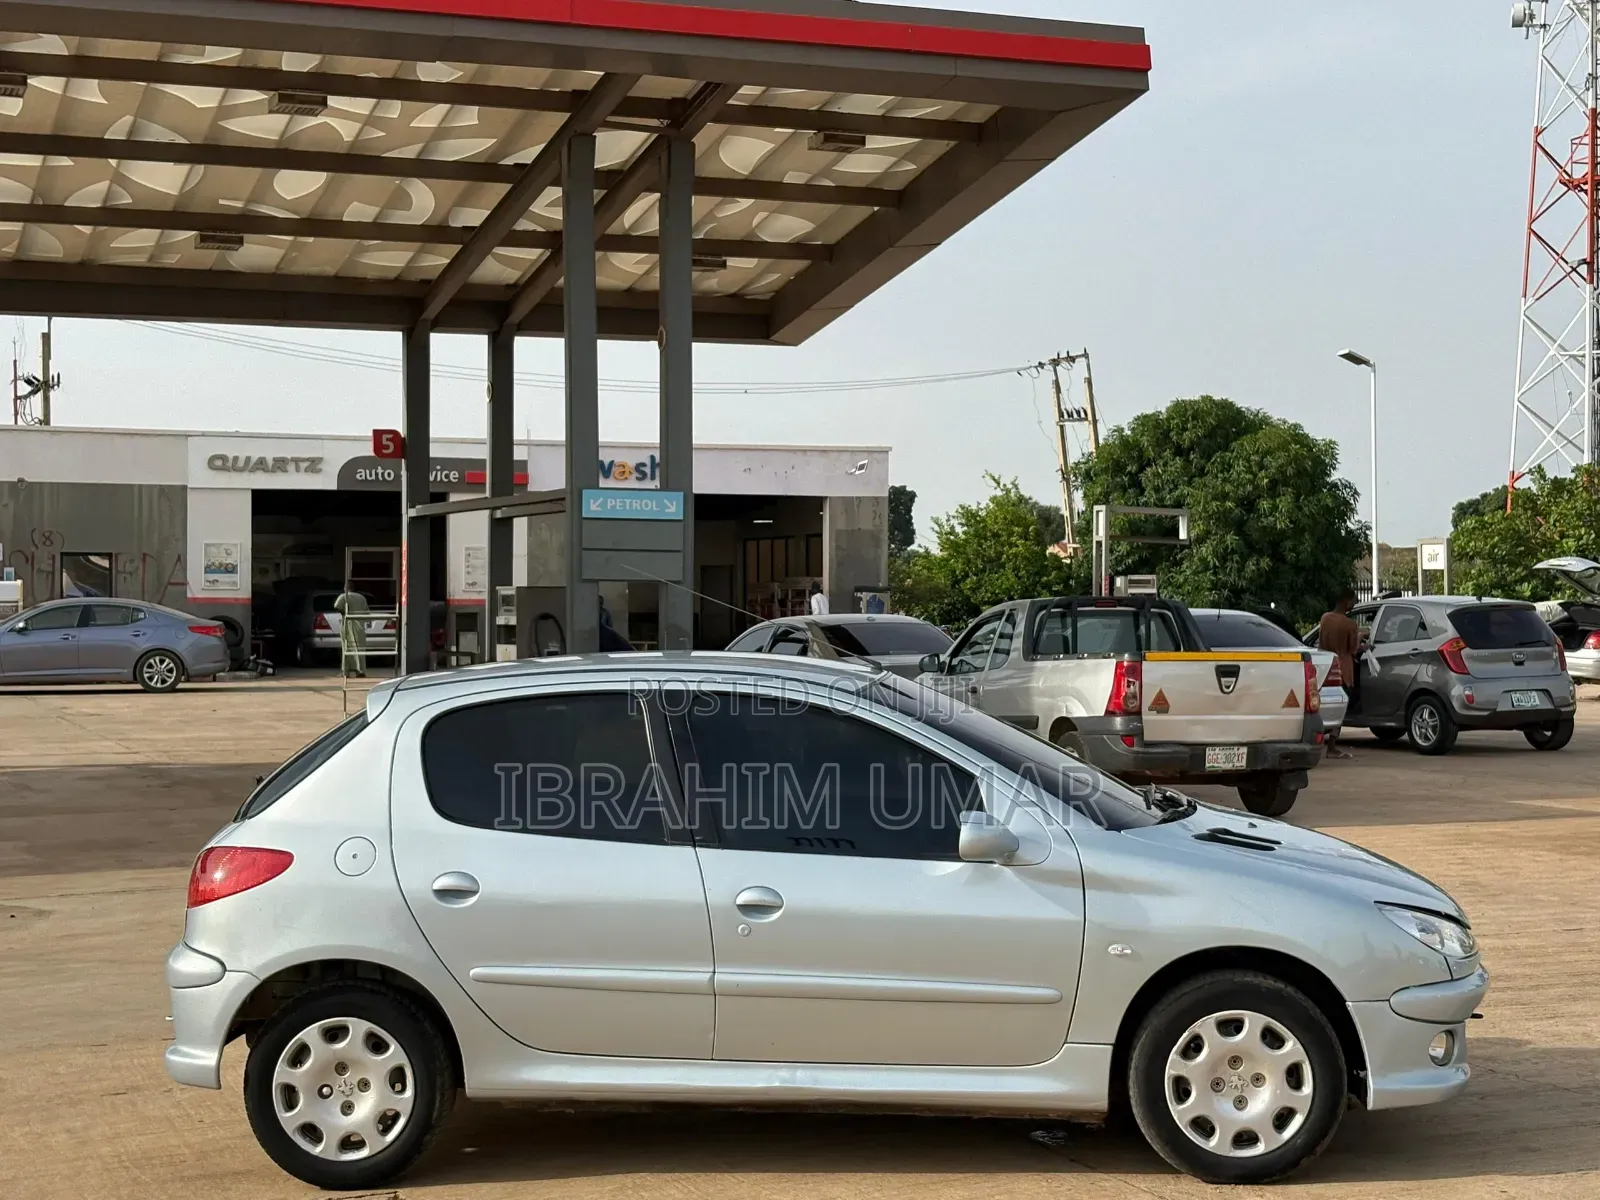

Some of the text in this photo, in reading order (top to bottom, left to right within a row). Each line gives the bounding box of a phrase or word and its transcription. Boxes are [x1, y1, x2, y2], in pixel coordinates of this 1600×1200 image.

[381, 433, 395, 454] 5
[207, 453, 324, 473] QUARTZ
[356, 465, 395, 481] auto
[607, 499, 661, 511] PETROL
[1427, 549, 1439, 562] air
